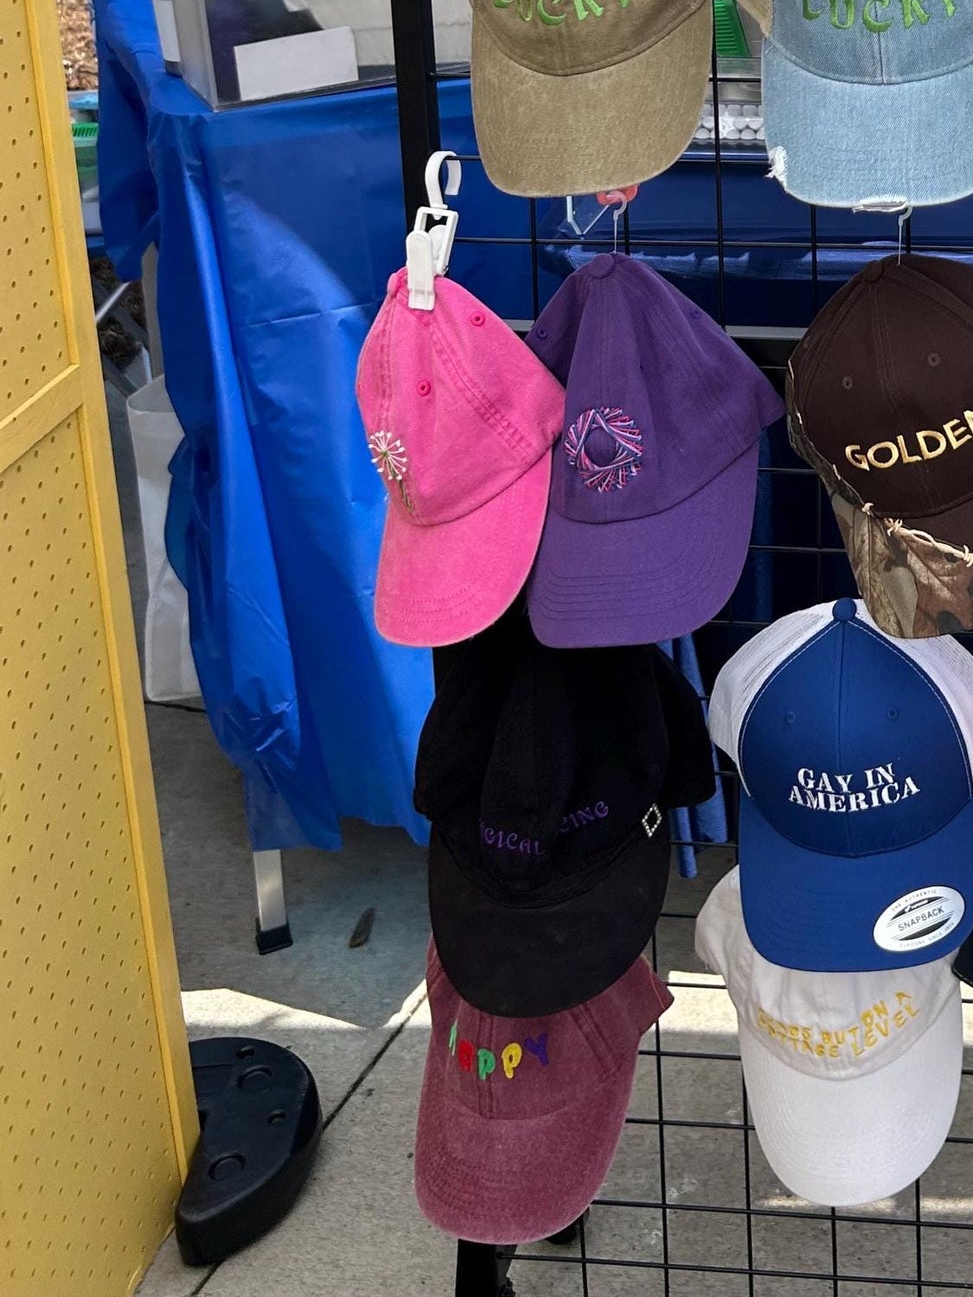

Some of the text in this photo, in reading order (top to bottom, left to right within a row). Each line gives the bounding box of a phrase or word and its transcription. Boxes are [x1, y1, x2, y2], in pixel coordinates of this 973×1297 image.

[797, 763, 895, 793] GAY IN
[788, 776, 920, 813] AMERICA
[897, 906, 945, 931] SNAPBACK
[820, 1026, 860, 1045] BUT
[852, 1003, 920, 1057] LEVEL
